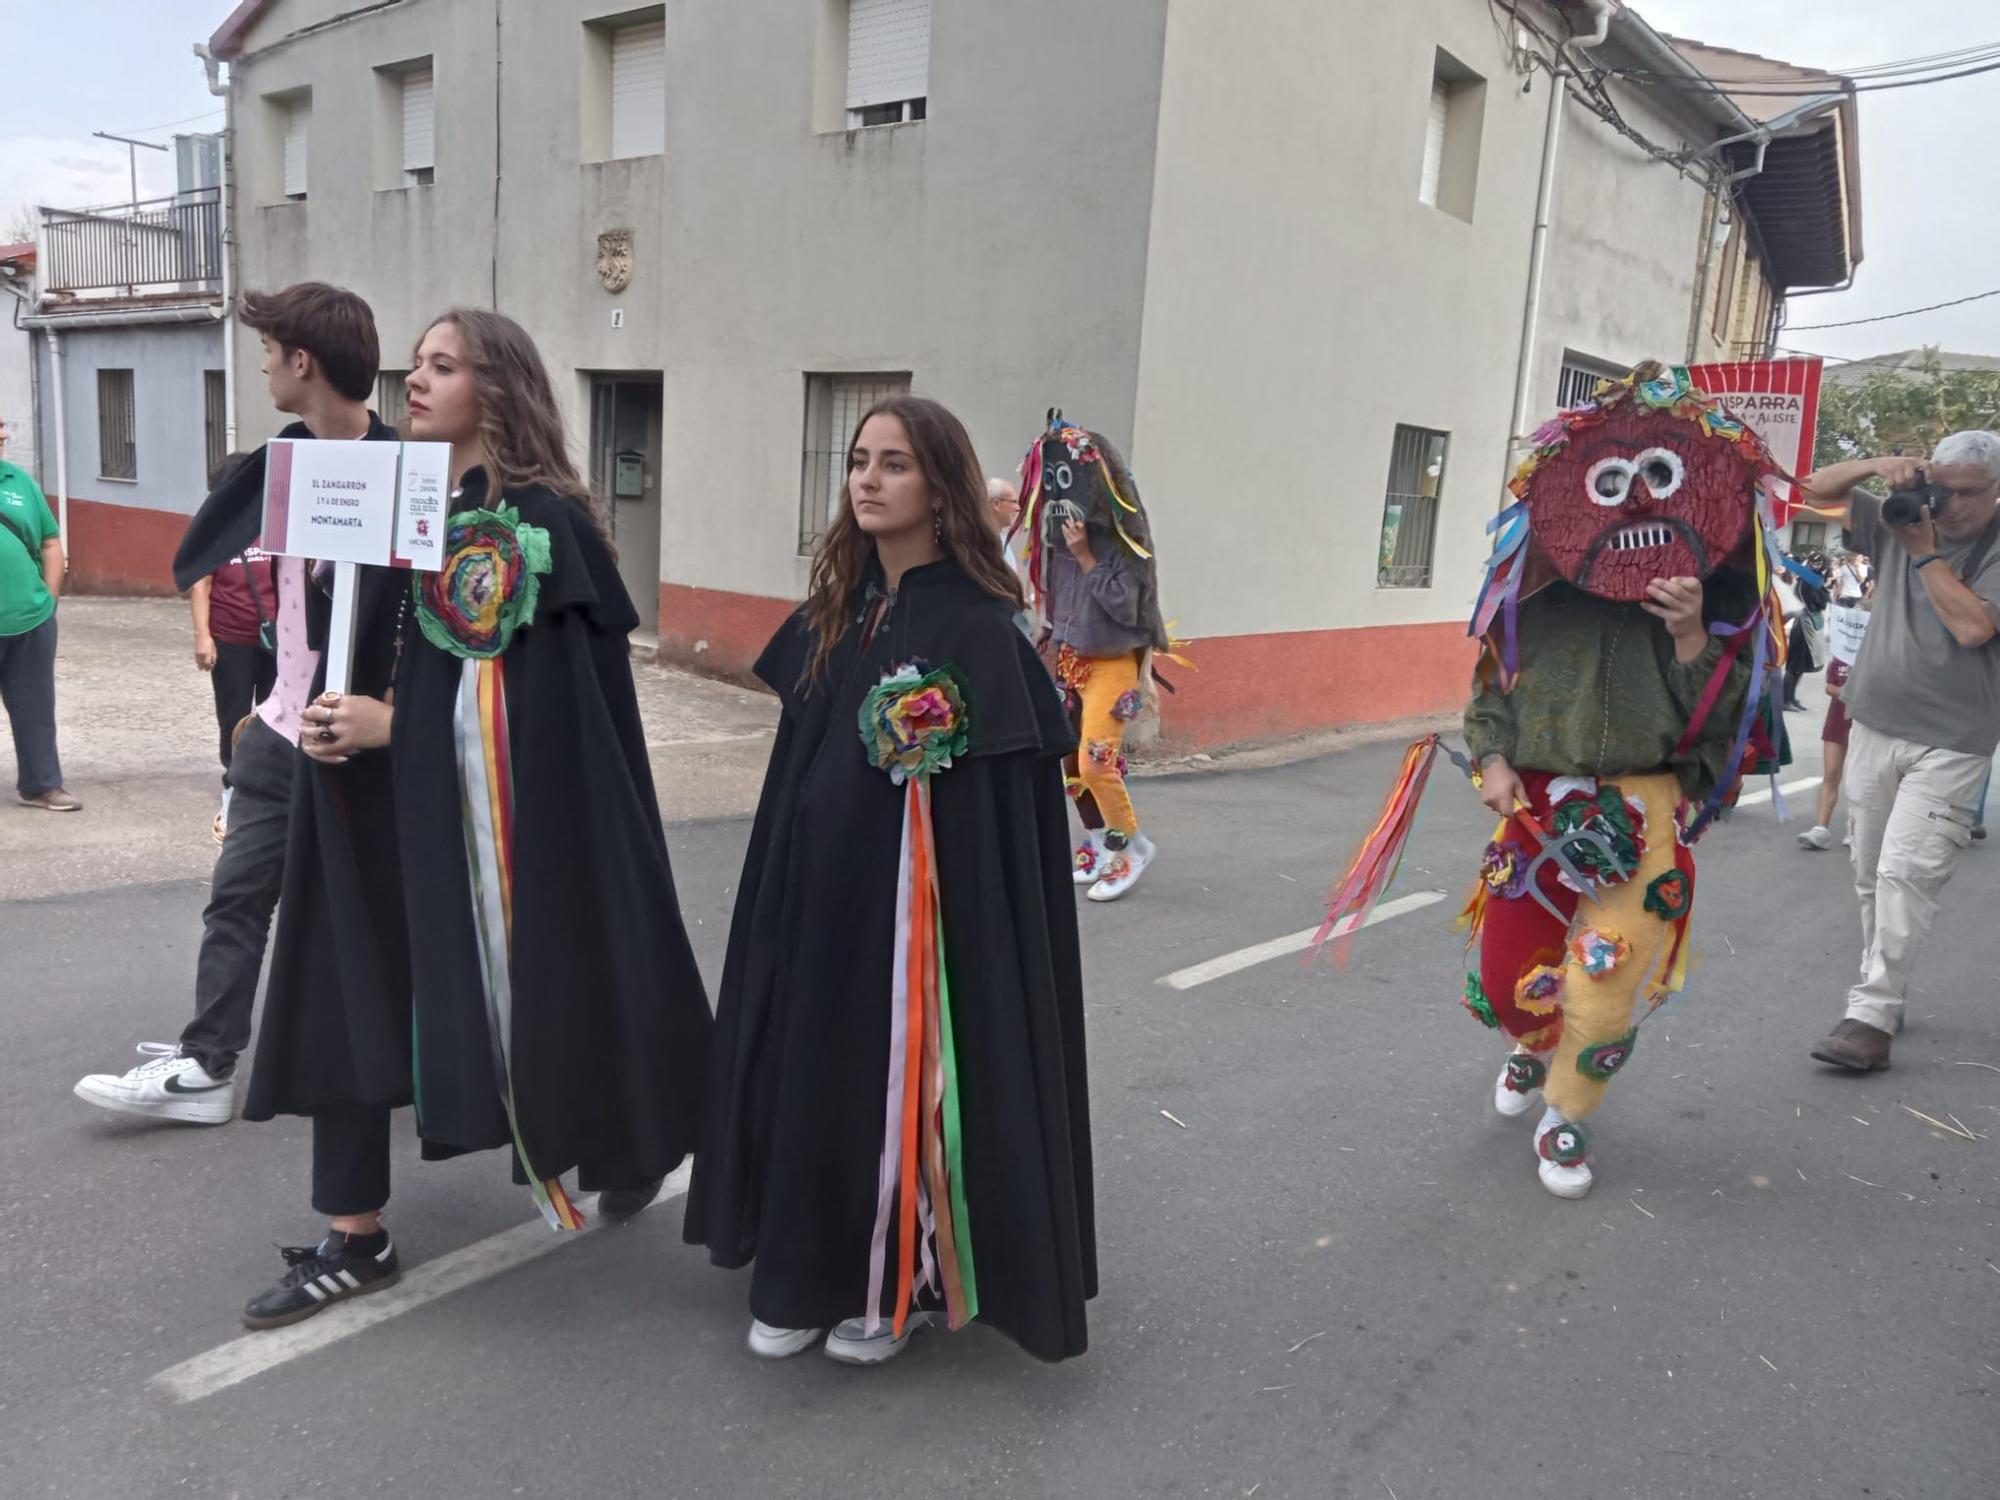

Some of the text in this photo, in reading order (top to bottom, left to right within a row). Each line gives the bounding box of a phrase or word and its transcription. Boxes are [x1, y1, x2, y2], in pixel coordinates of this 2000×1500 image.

[1725, 396, 1800, 411] ISPARRA
[1757, 412, 1798, 425] ALISTE
[312, 479, 320, 489] EL
[311, 514, 363, 528] MONTAMARTA
